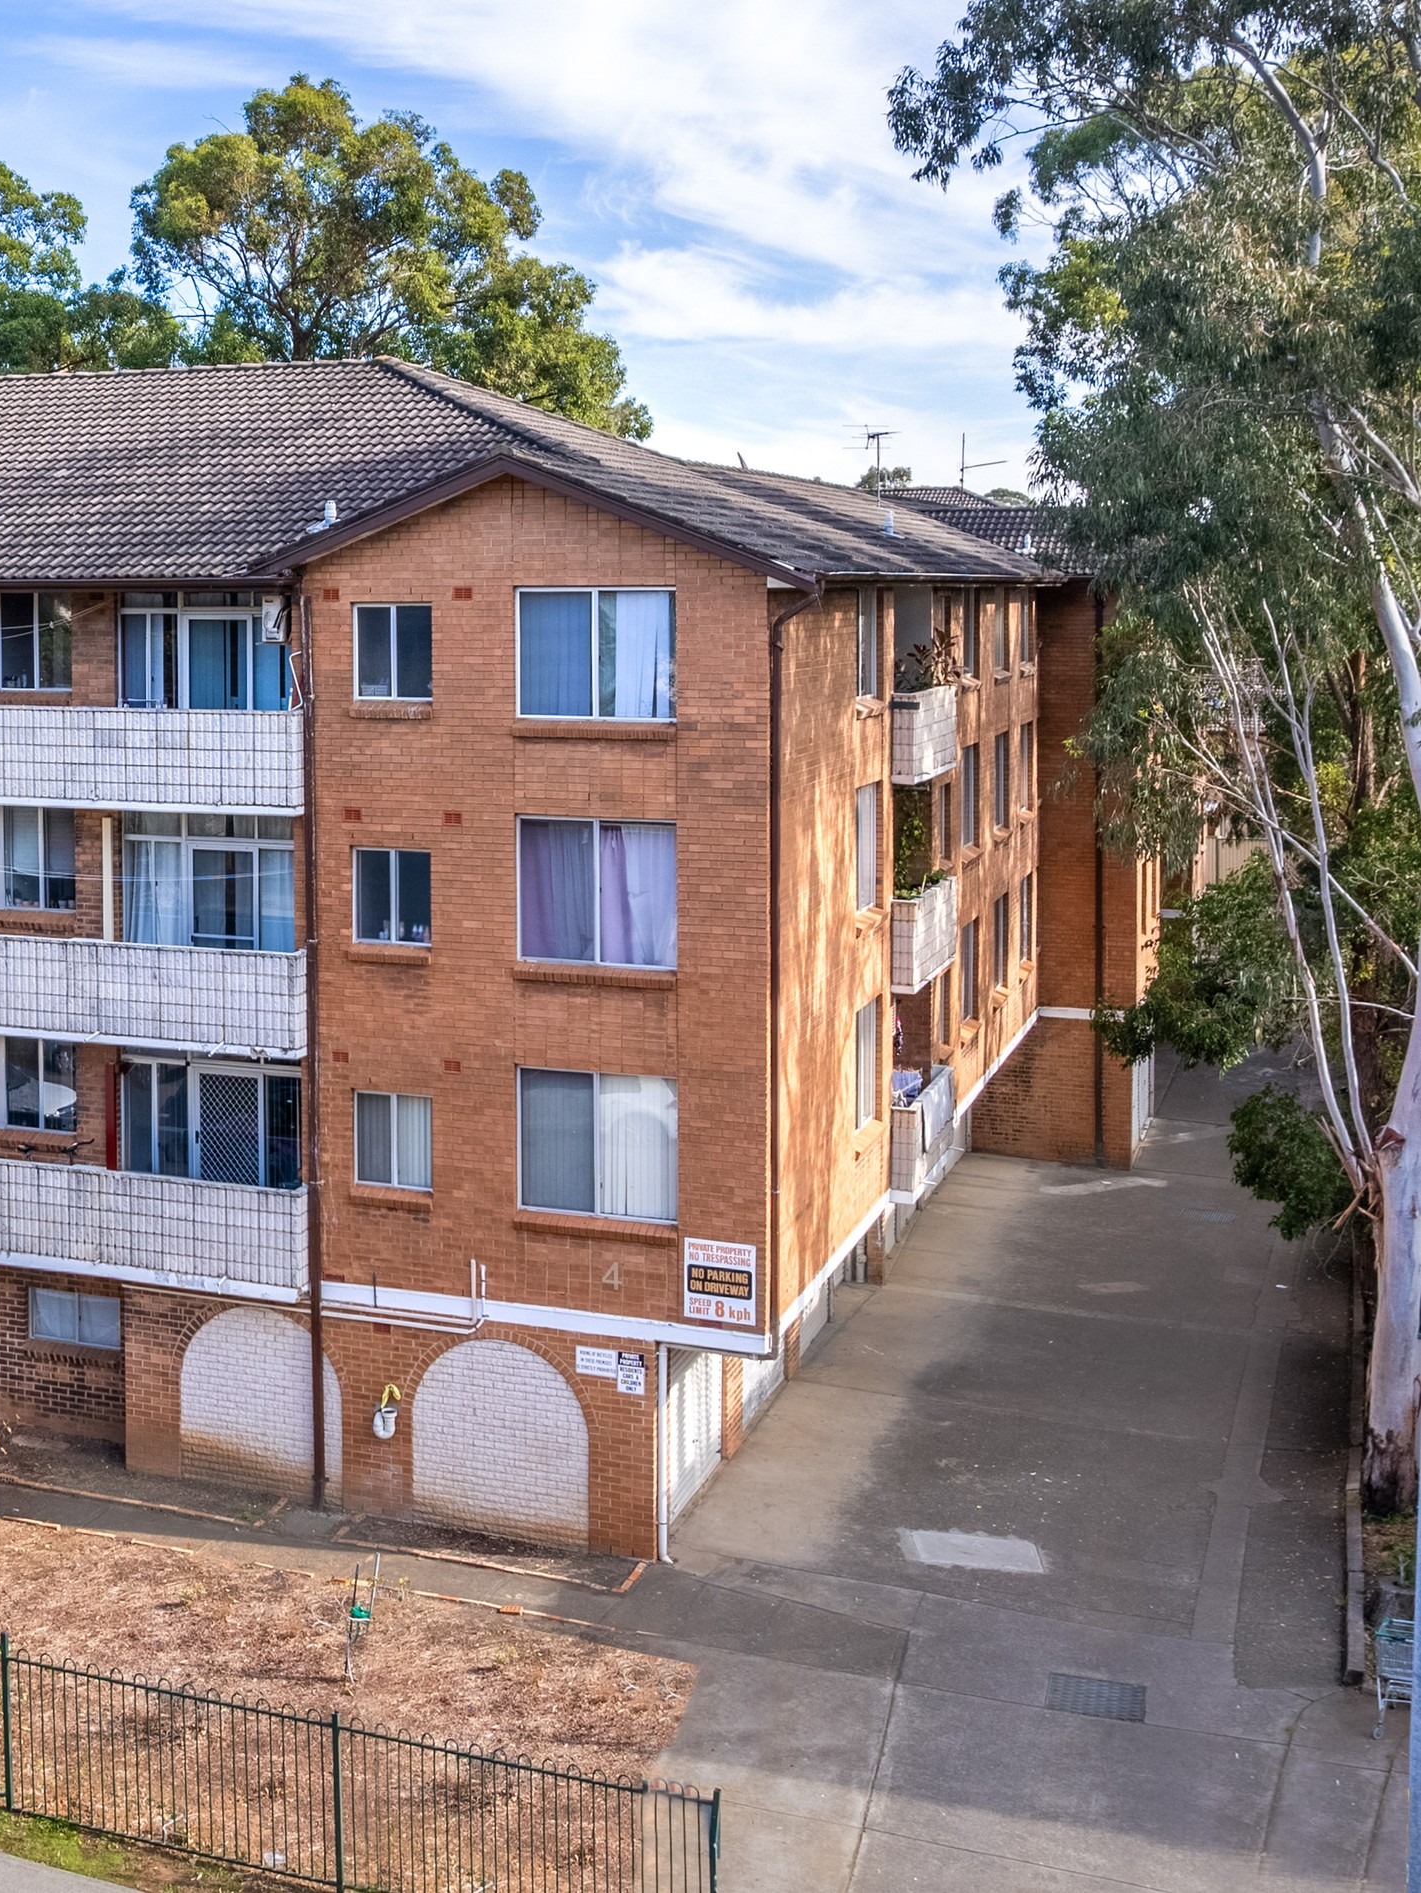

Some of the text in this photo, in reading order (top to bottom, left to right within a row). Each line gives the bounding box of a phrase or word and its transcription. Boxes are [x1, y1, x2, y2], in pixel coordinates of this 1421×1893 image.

[688, 1242, 751, 1257] PRIVATE PROPERTY
[689, 1251, 751, 1267] NO TRESPASSING
[602, 1262, 623, 1290] 4
[691, 1267, 749, 1285] NO PARKING
[690, 1280, 749, 1297] ON DRIVEWAY
[689, 1297, 711, 1307] SPEED
[689, 1306, 709, 1315] LIMIT
[715, 1300, 751, 1322] 8 kph
